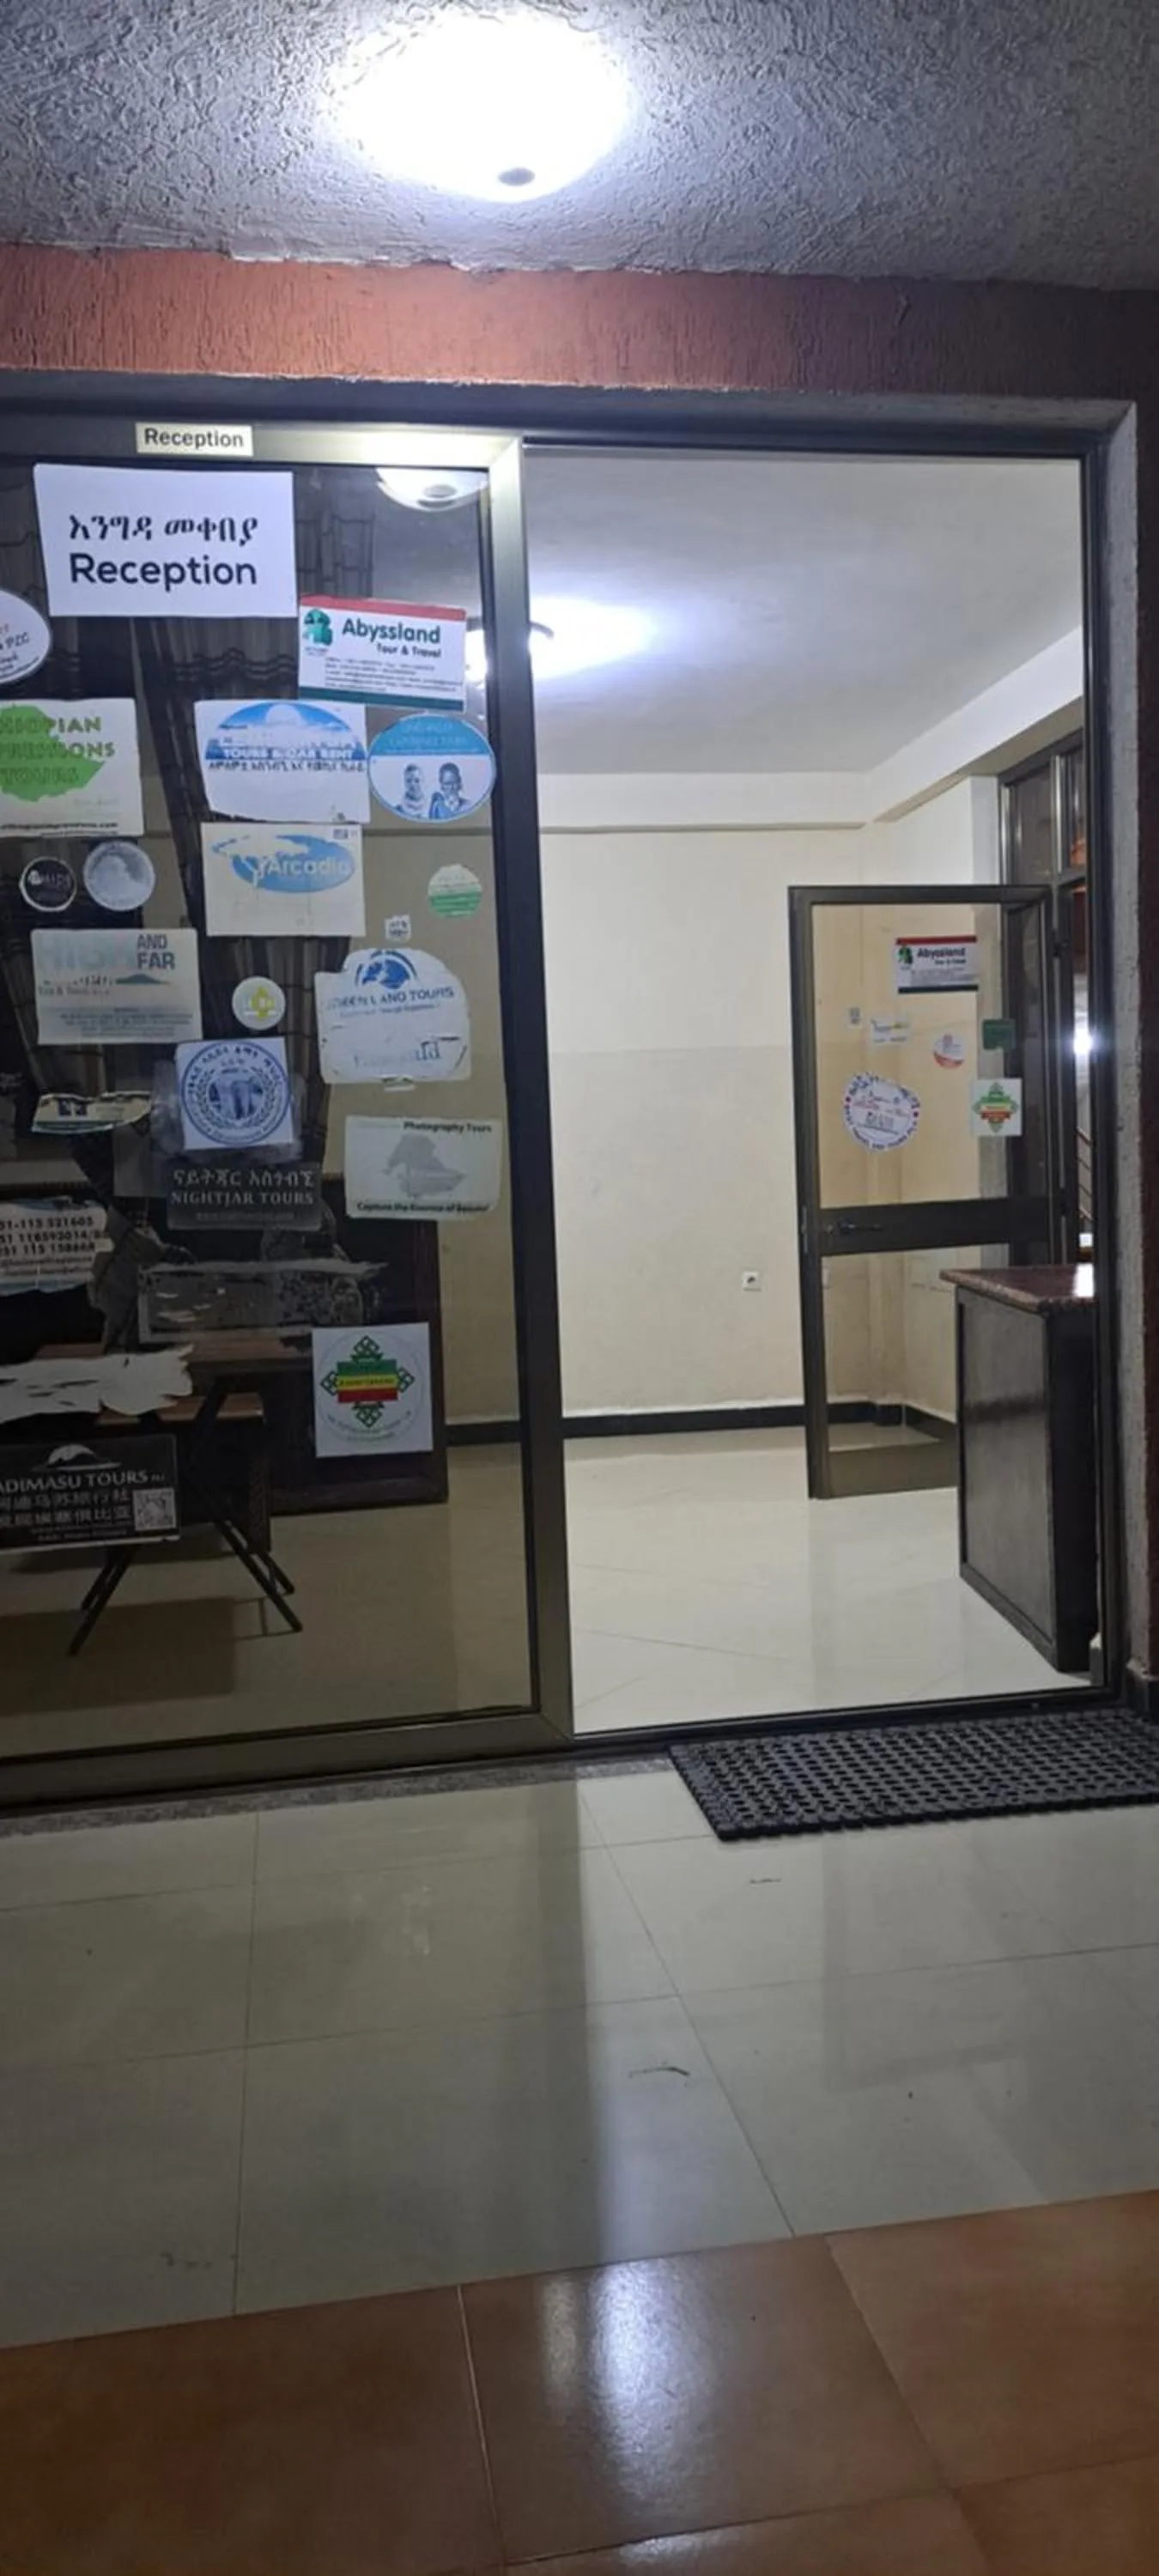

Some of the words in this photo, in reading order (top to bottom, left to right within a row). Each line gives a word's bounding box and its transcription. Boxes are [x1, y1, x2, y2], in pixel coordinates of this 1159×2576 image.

[144, 428, 244, 449] Reception
[70, 514, 153, 541] እንግዳ
[164, 517, 258, 547] መቀበያ
[70, 552, 257, 592] Reception
[343, 617, 440, 644] Abyssland
[402, 645, 410, 655] &
[137, 933, 167, 950] AND
[137, 951, 176, 970] FAR
[409, 987, 454, 1001] TOURS
[403, 1121, 464, 1134] Photography
[465, 1121, 492, 1133] Tours
[171, 1190, 254, 1208] NIGHTJAR
[258, 1191, 314, 1206] TOURS
[86, 1469, 149, 1488] TOURS
